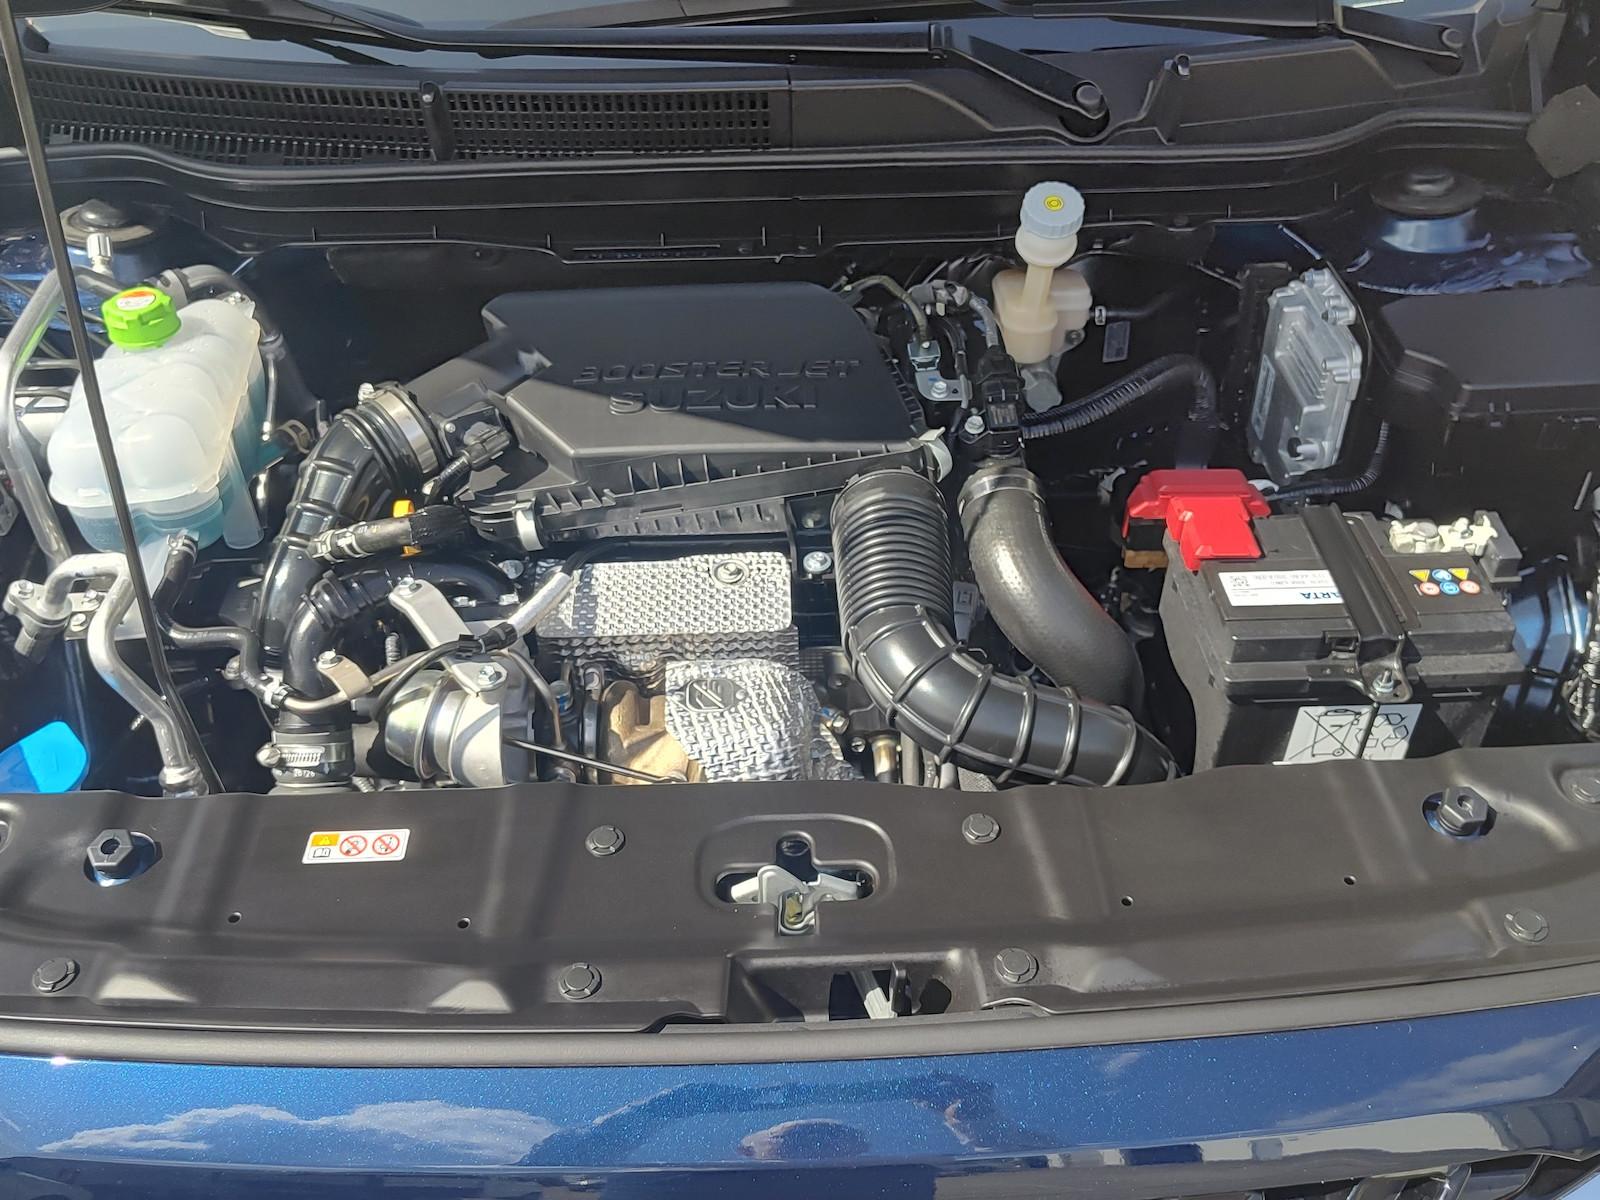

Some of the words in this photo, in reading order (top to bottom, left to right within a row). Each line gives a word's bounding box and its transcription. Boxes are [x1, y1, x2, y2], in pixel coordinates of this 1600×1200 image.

[572, 359, 860, 383] BOOSTERJET
[608, 385, 818, 416] SUZUKI
[1299, 591, 1342, 600] ARTA
